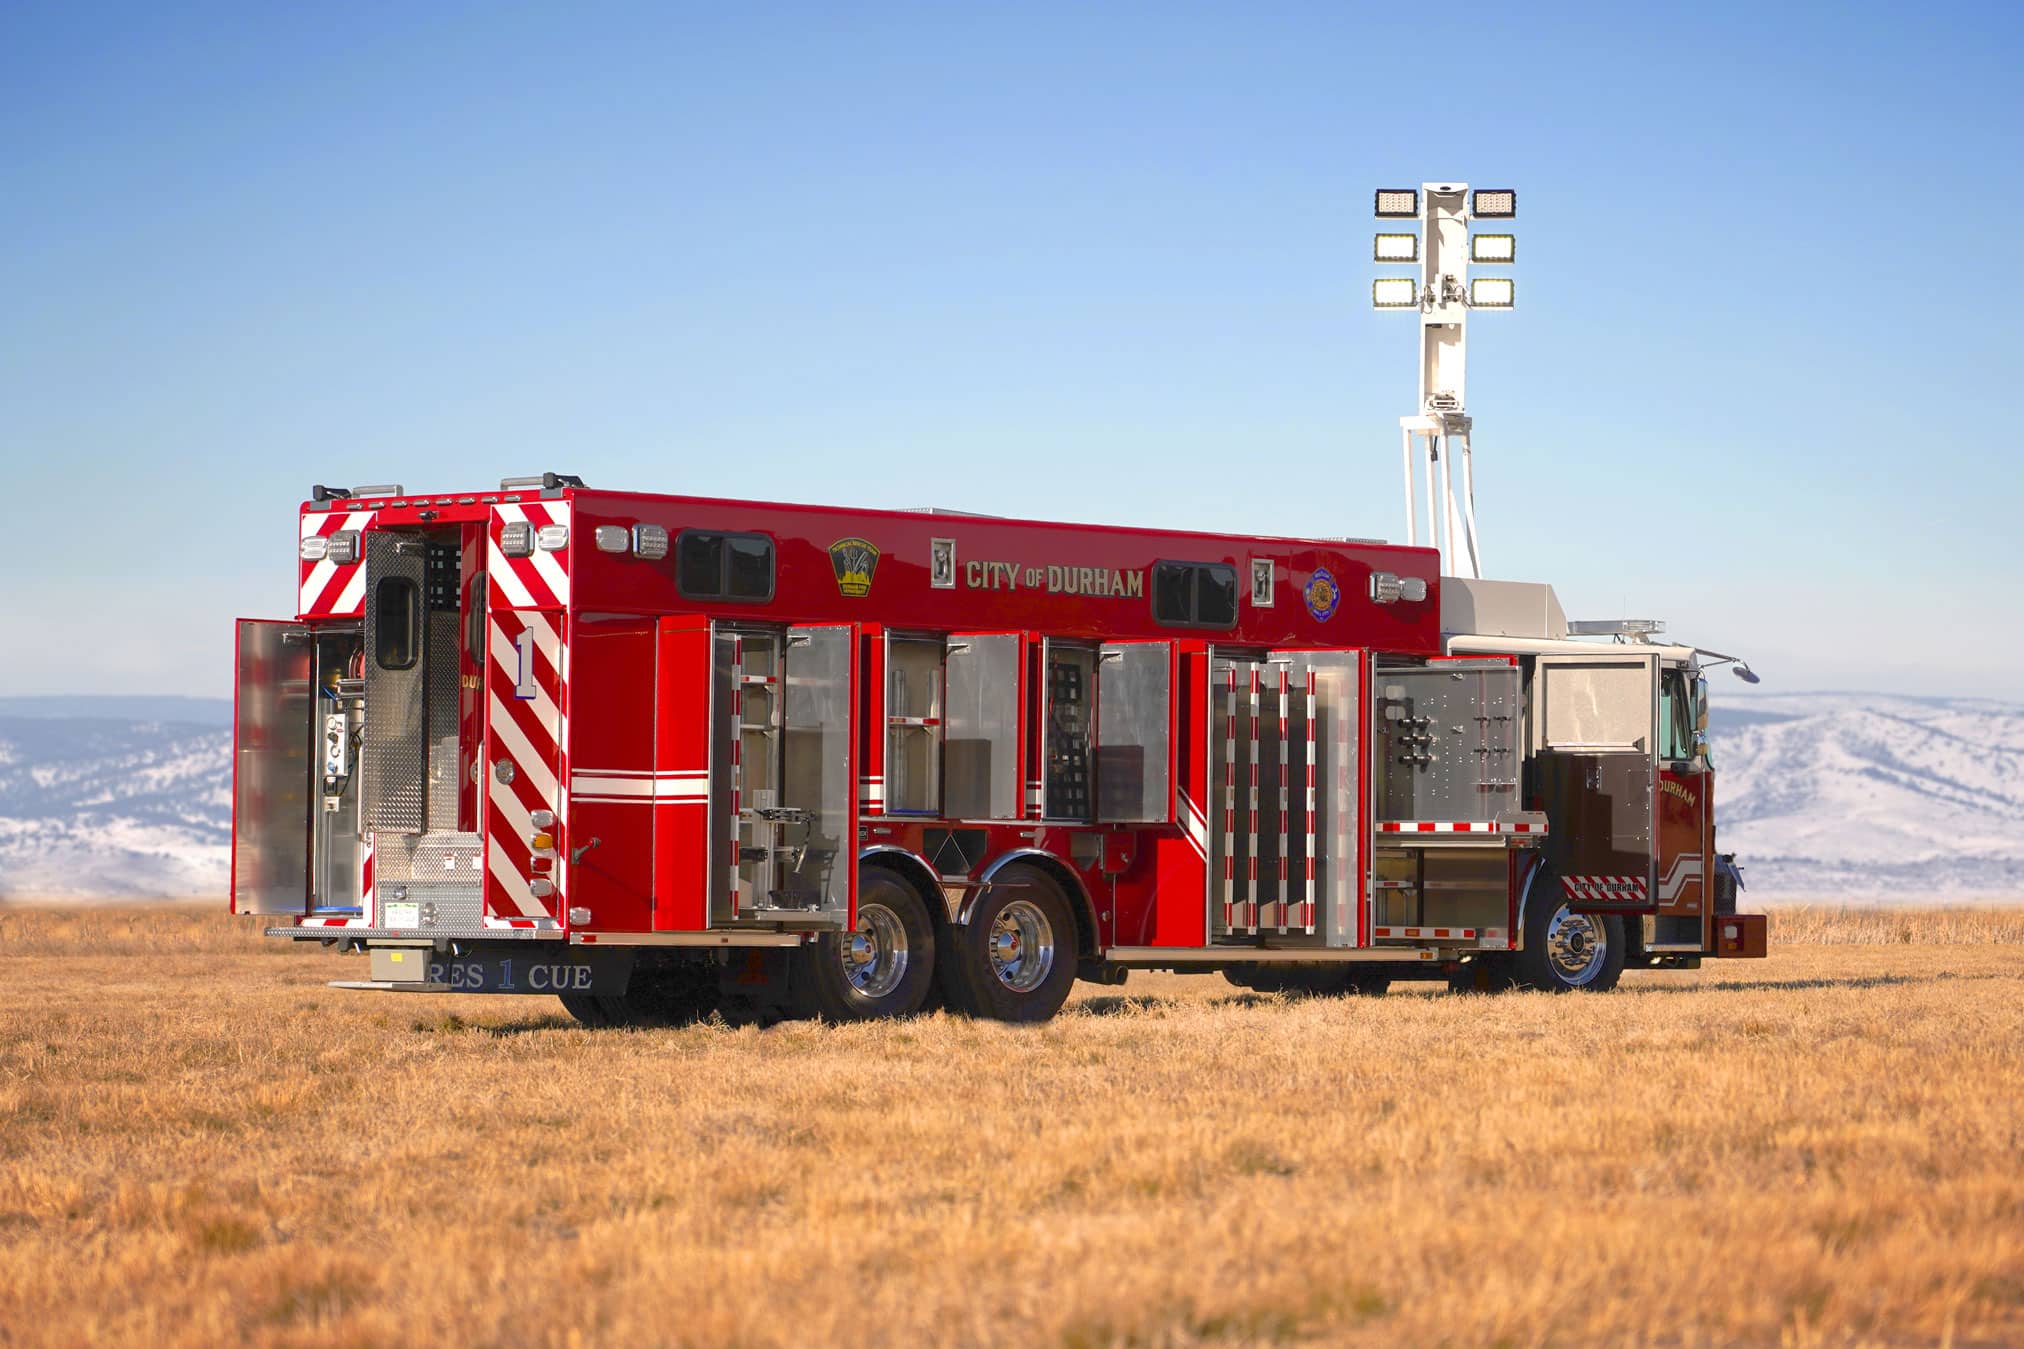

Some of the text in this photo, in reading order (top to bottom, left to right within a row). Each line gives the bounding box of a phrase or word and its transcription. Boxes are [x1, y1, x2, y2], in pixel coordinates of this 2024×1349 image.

[965, 560, 1144, 598] CITY OF DURHAM
[514, 626, 537, 699] 1
[1574, 882, 1640, 893] CITY OF DURHAM
[430, 958, 593, 990] RES 1 CUE
